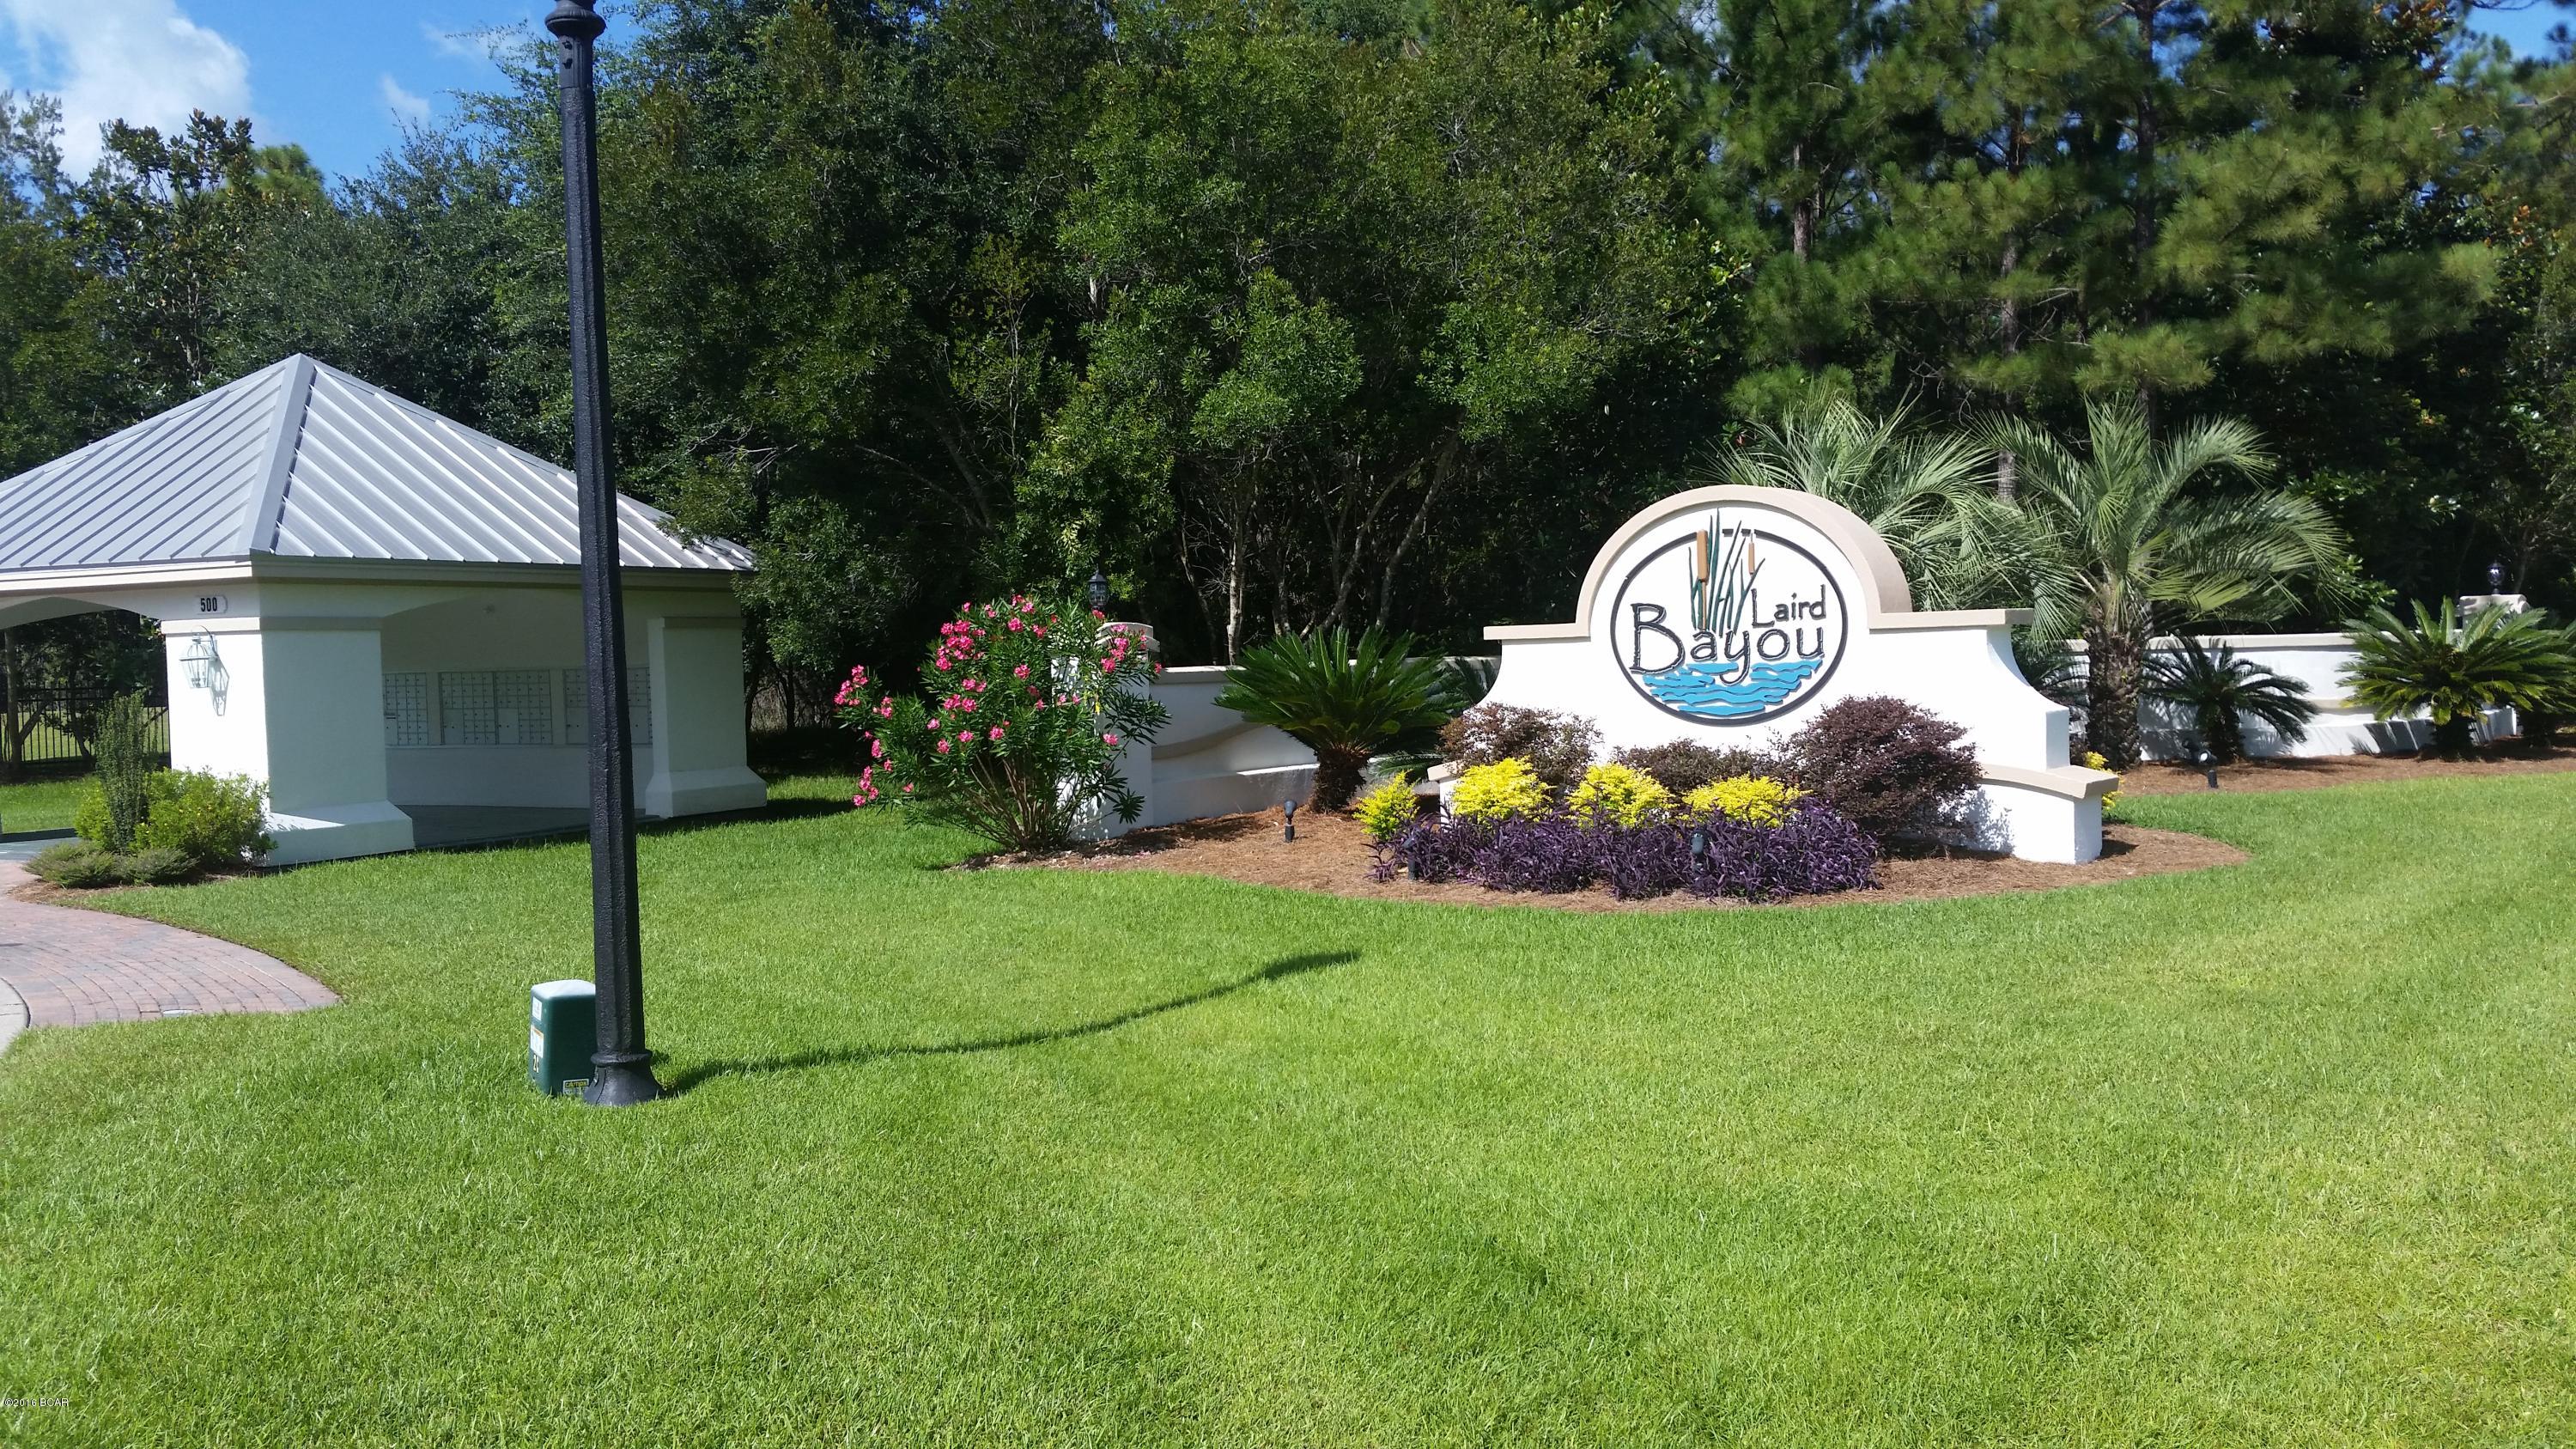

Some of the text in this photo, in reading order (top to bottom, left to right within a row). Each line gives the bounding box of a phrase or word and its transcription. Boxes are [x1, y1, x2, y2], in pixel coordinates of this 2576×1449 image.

[200, 596, 218, 612] 500
[1751, 584, 1826, 628] Laird
[1629, 602, 1826, 685] Bayou
